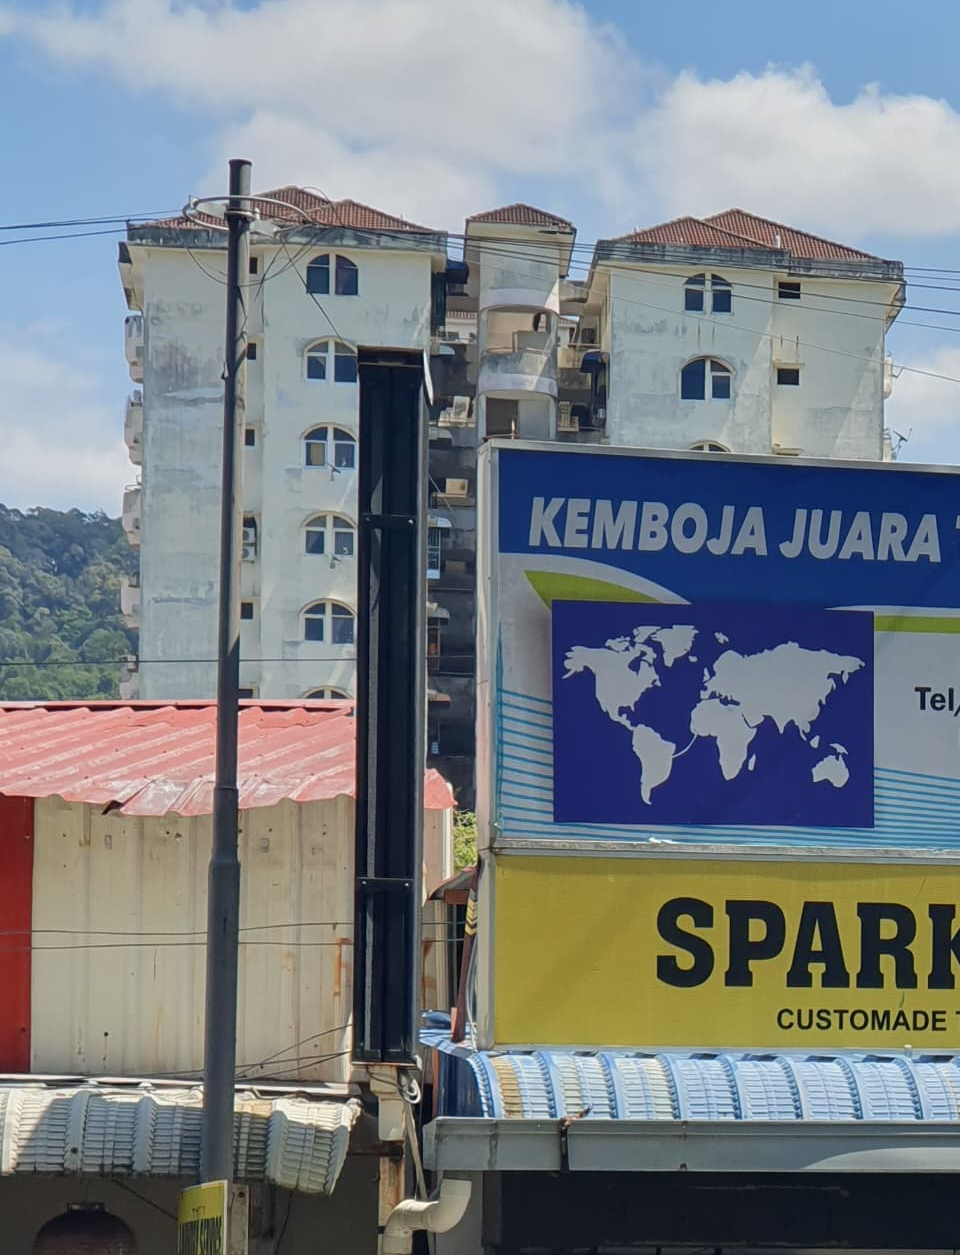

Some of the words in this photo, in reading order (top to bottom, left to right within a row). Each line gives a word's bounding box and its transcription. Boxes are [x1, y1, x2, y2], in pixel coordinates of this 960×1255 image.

[528, 496, 767, 557] KEMBOJA
[779, 508, 941, 563] JUARA
[776, 1008, 947, 1032] CUSTOMADE
